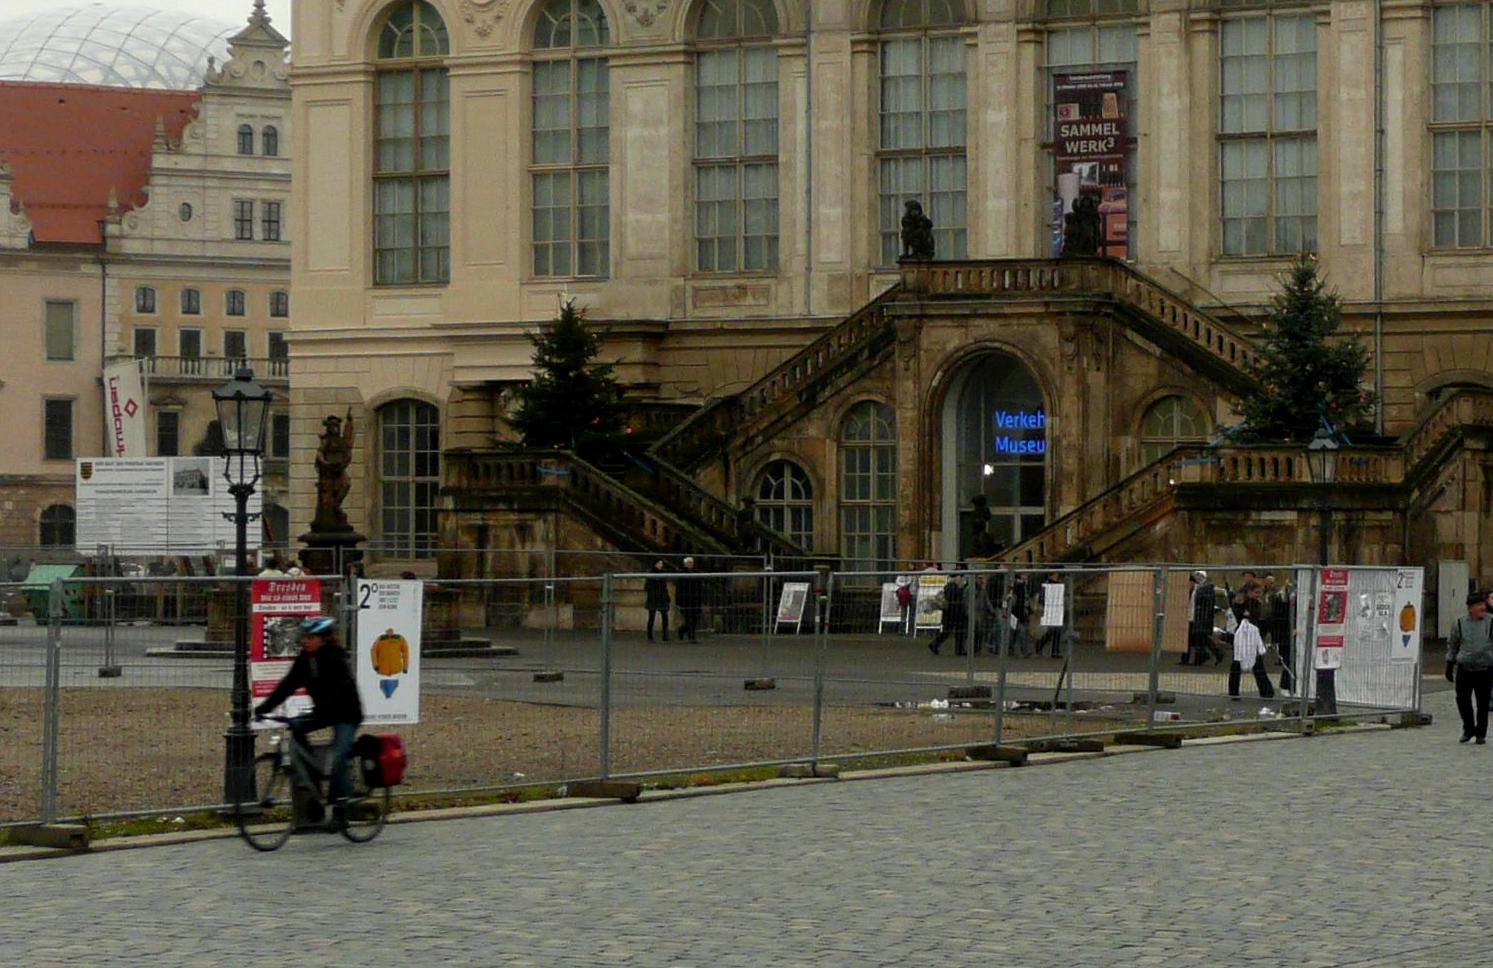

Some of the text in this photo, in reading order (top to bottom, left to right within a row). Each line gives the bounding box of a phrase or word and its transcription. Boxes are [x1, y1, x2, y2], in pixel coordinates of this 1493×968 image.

[1061, 123, 1120, 137] SAMMEL
[995, 410, 1045, 428] Verkeh
[995, 435, 1045, 453] Museu
